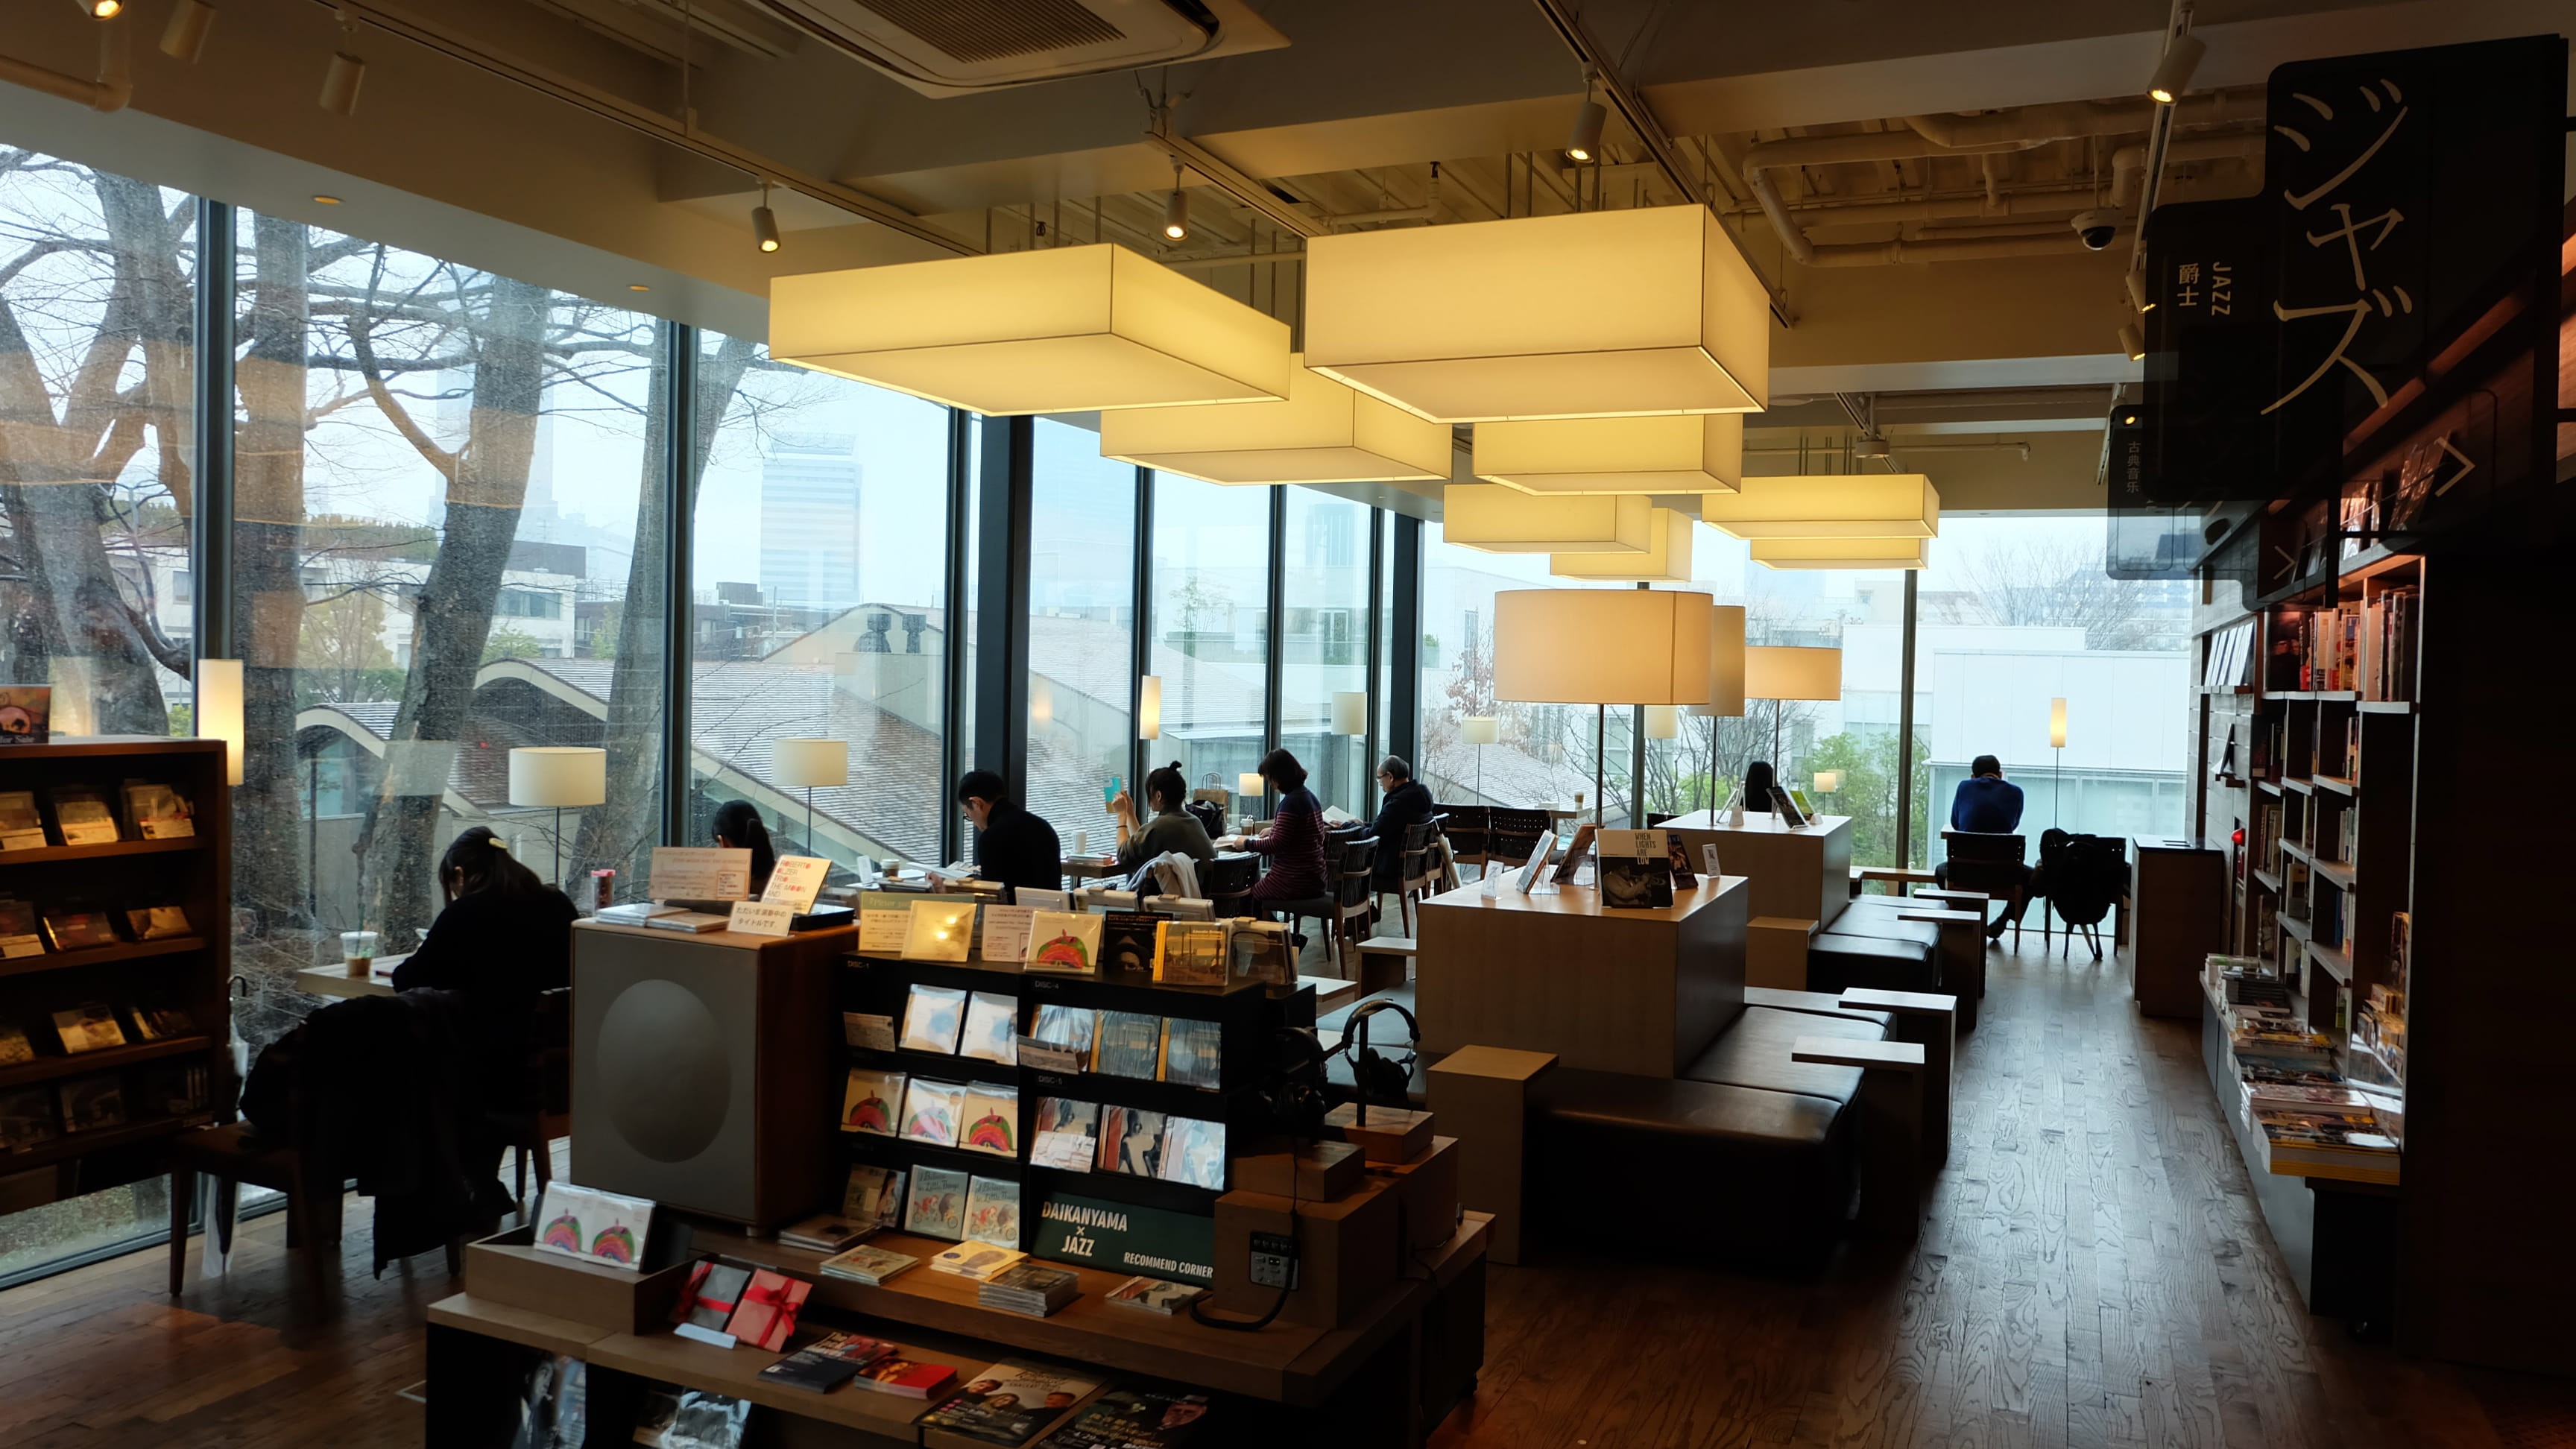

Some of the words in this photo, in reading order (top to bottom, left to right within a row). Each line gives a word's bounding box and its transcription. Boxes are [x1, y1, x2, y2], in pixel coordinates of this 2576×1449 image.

[2261, 78, 2412, 414] ジャズ
[2177, 264, 2200, 307] 爵士
[2212, 262, 2232, 316] JAZZ
[2126, 441, 2142, 493] 古典音乐
[1635, 840, 1656, 848] LIGHTS
[1638, 856, 1650, 865] LOW
[1041, 1201, 1128, 1232] DAIKANYAMA
[1061, 1235, 1095, 1257] JAZZ
[1123, 1251, 1177, 1272] RECOMMEND
[1178, 1261, 1213, 1279] CORNER
